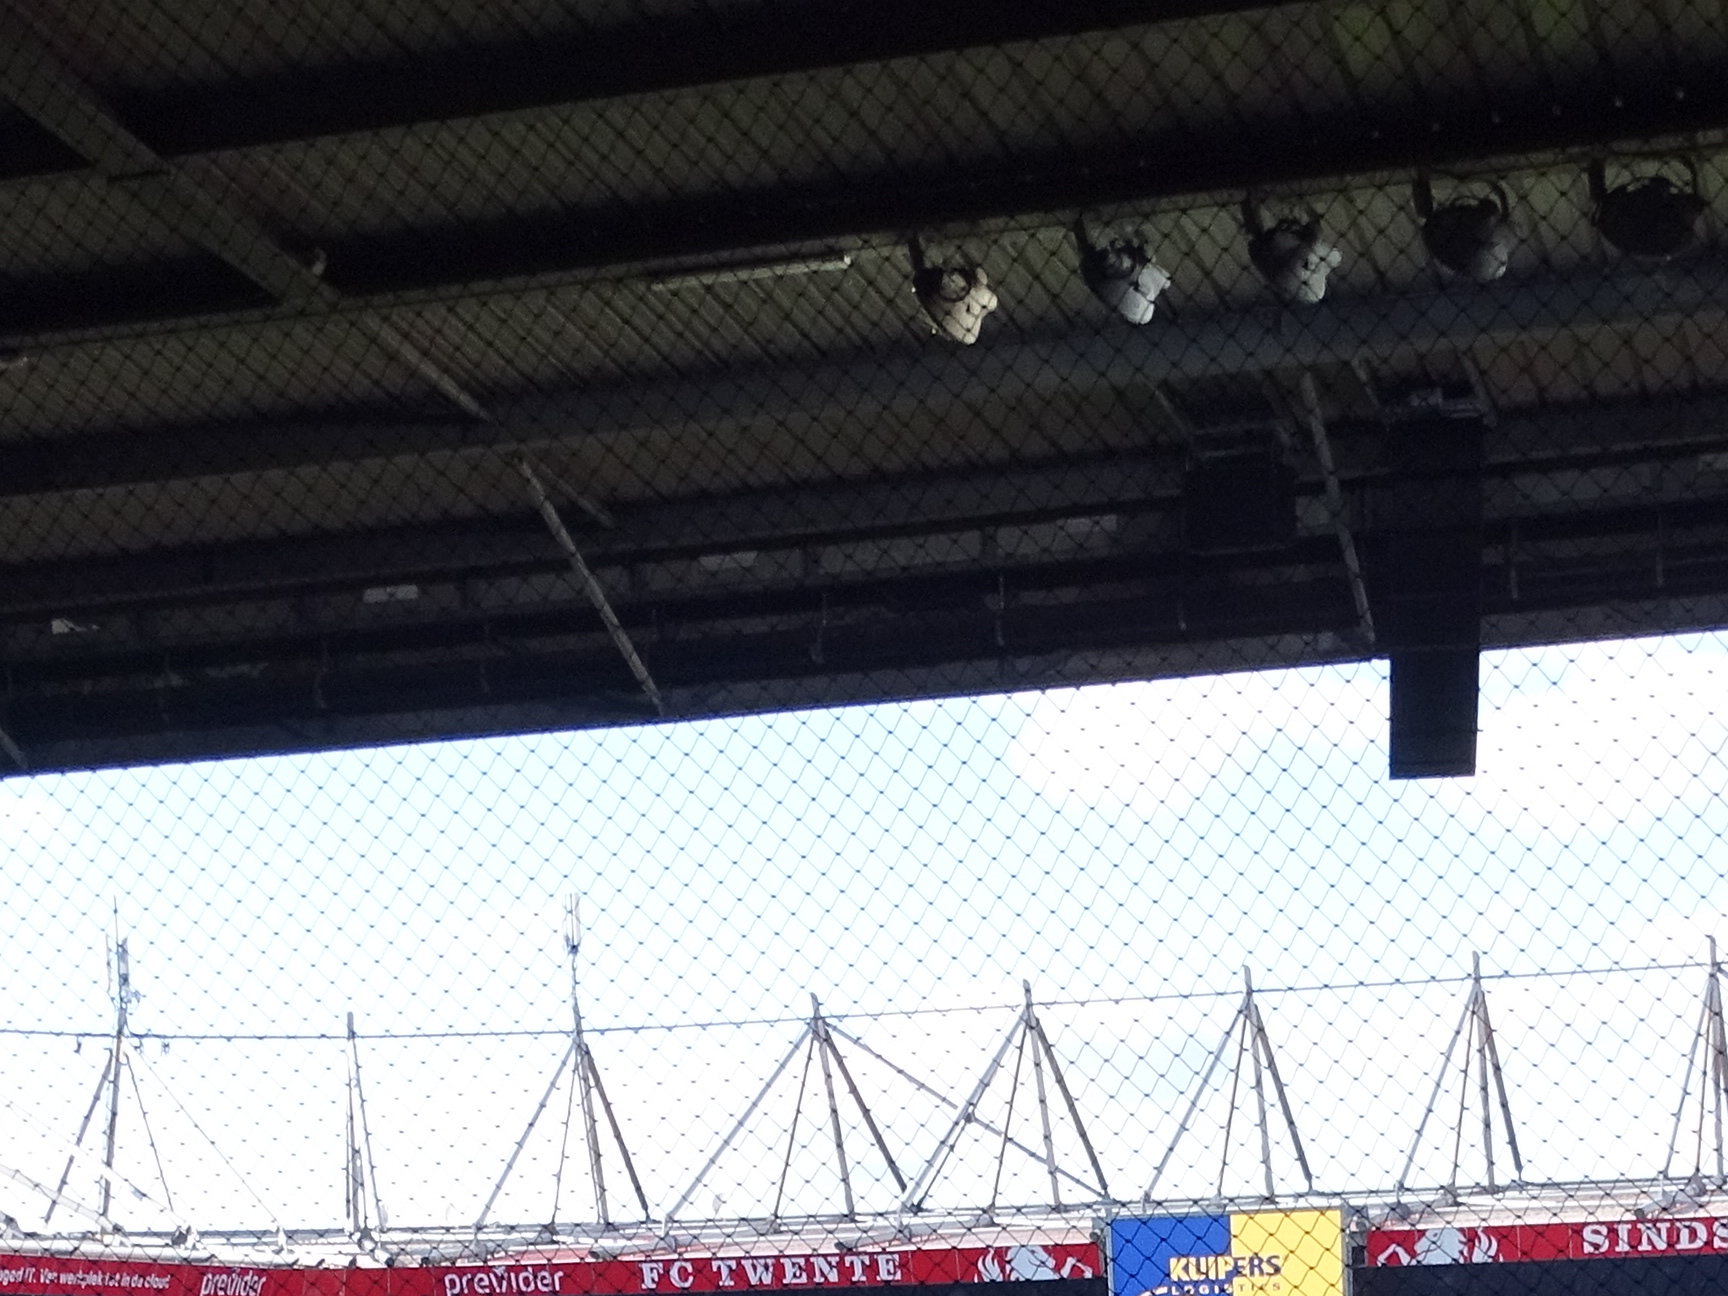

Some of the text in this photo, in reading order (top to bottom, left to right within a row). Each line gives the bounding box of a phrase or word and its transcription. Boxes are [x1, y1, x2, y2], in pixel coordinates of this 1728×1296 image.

[639, 1253, 903, 1292] FC TWENTE
[1169, 1255, 1281, 1281] KUIPERS
